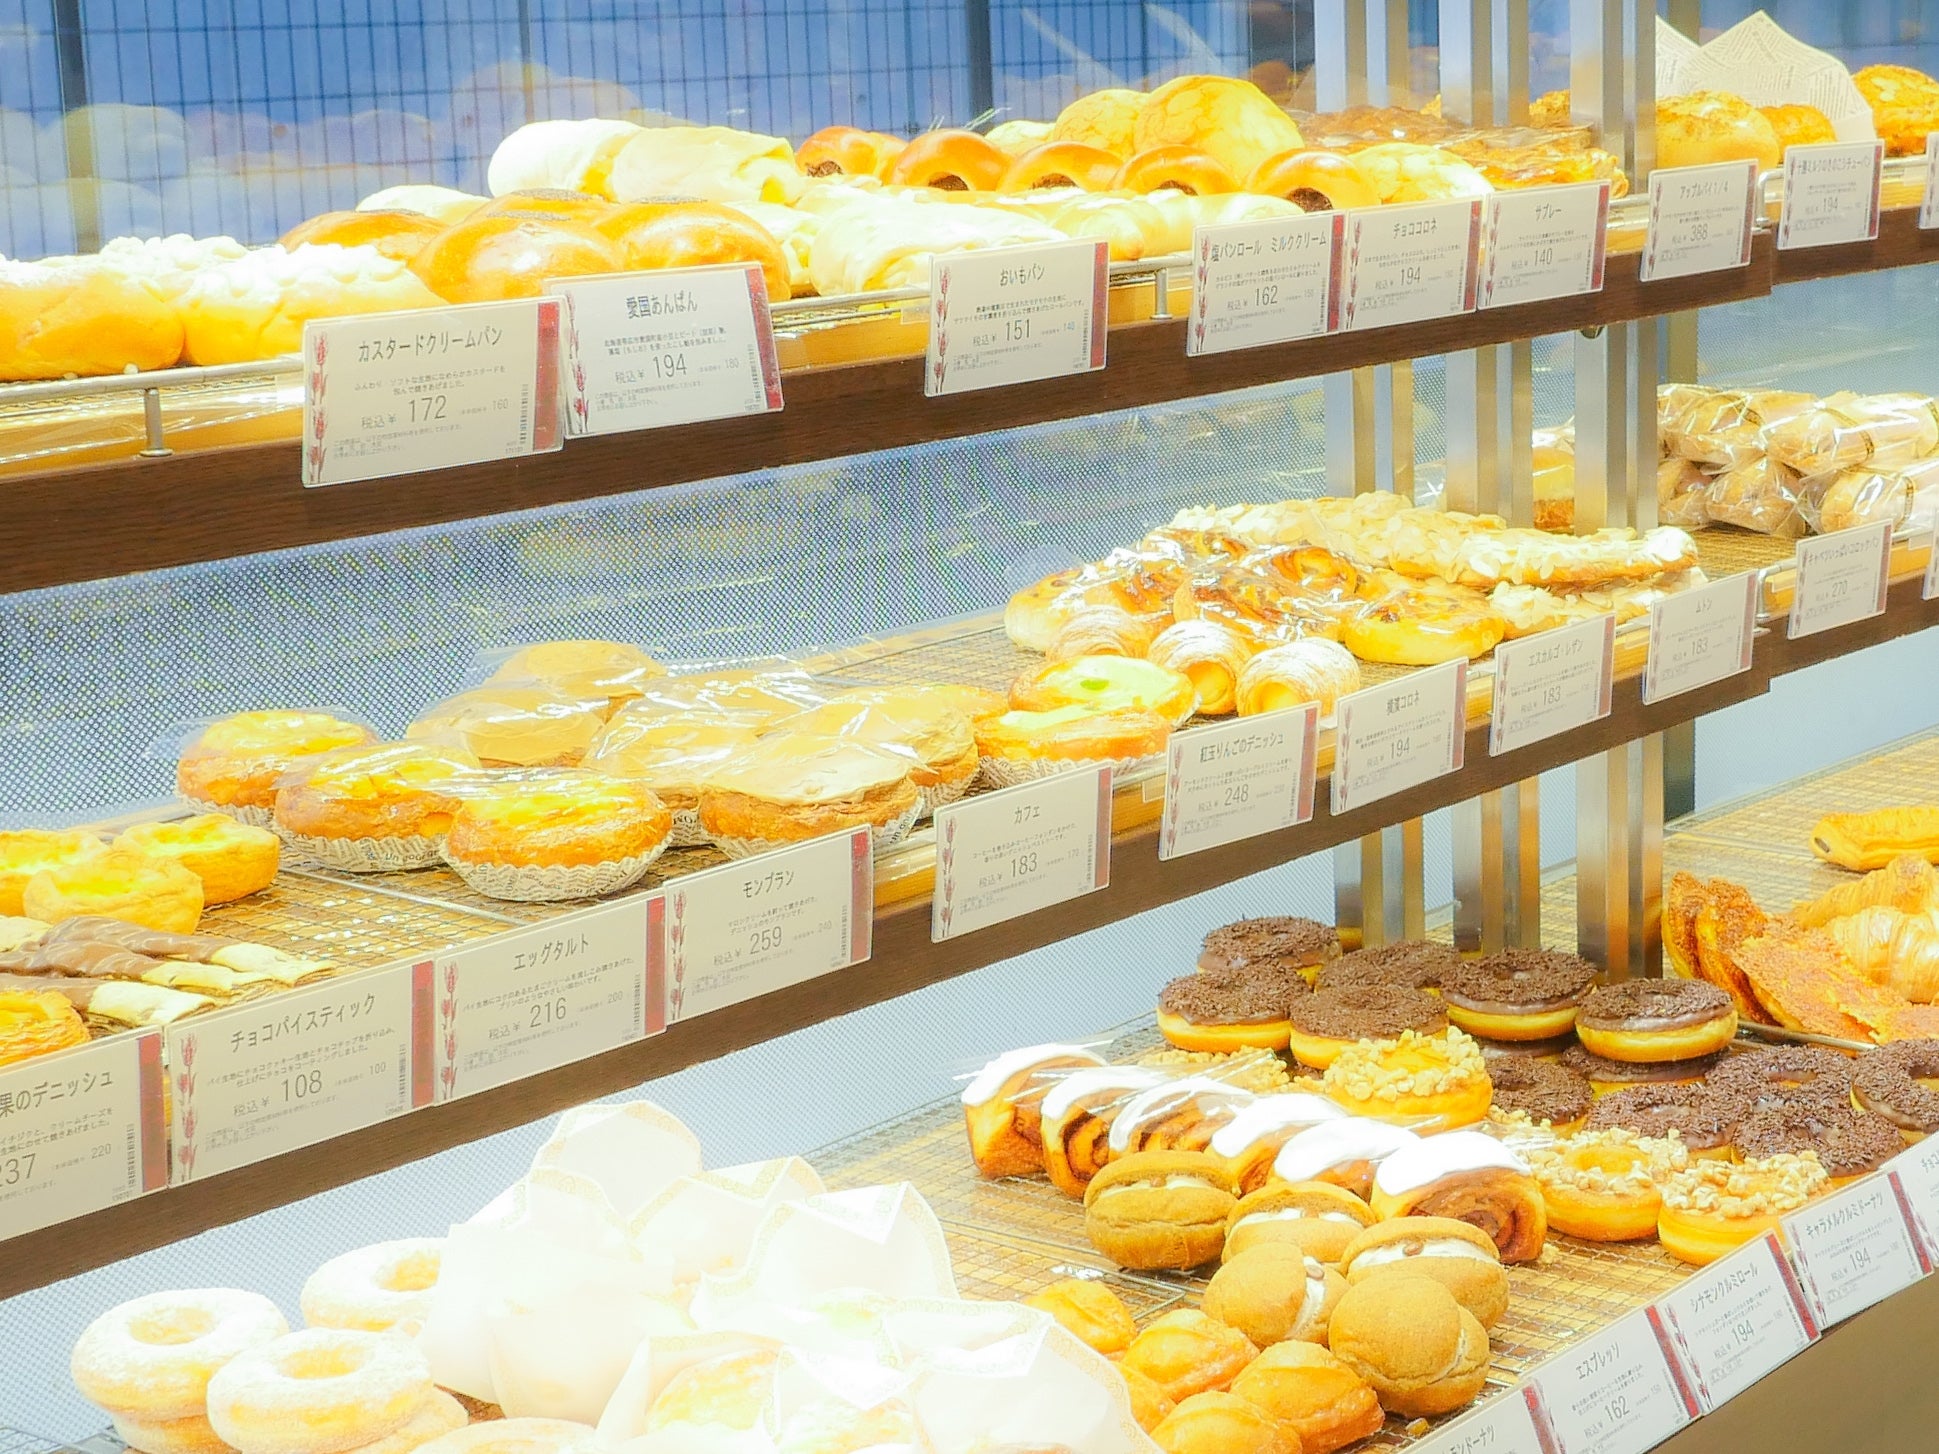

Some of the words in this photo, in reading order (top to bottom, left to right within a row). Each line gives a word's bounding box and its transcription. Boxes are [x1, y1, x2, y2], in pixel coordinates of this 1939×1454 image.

[1393, 218, 1437, 239] チョココロネ
[1211, 240, 1262, 262] 塩パンロール
[1271, 230, 1327, 252] ミルククリーム
[1534, 248, 1553, 266] 140
[1000, 263, 1046, 287] おいもパン
[1400, 266, 1421, 286] 194
[626, 290, 698, 319] 愛国あんぱん
[1255, 285, 1278, 306] 162
[358, 325, 503, 363] カスタードクリームパン
[1005, 319, 1031, 342] 151
[652, 352, 688, 379] 194
[724, 358, 740, 370] 180
[408, 395, 448, 423] 172
[492, 399, 509, 411] 160
[1543, 686, 1561, 706] 183
[1200, 732, 1284, 763] 紅玉りんごのデニッシュ
[1391, 737, 1410, 760] 194
[1224, 784, 1249, 806] 248
[1014, 805, 1040, 824] カフェ
[1011, 852, 1038, 877] 183
[743, 870, 796, 898] モンブラン
[513, 932, 589, 971] エッグタルト
[750, 926, 782, 955] 259
[230, 992, 375, 1053] チョコパイスティック
[529, 997, 567, 1028] 216
[607, 991, 624, 1004] 200
[281, 1069, 323, 1101] 108
[369, 1061, 387, 1076] 100
[0, 1153, 36, 1187] 37
[91, 1143, 112, 1160] 220
[1806, 1191, 1884, 1240] キャラメルクルミドーナツ
[1850, 1247, 1872, 1273] 194
[1690, 1262, 1758, 1313] シナモンクルミロール
[1731, 1319, 1755, 1346] 194
[1576, 1341, 1620, 1379] エスプレッソ
[1605, 1395, 1630, 1422] 162
